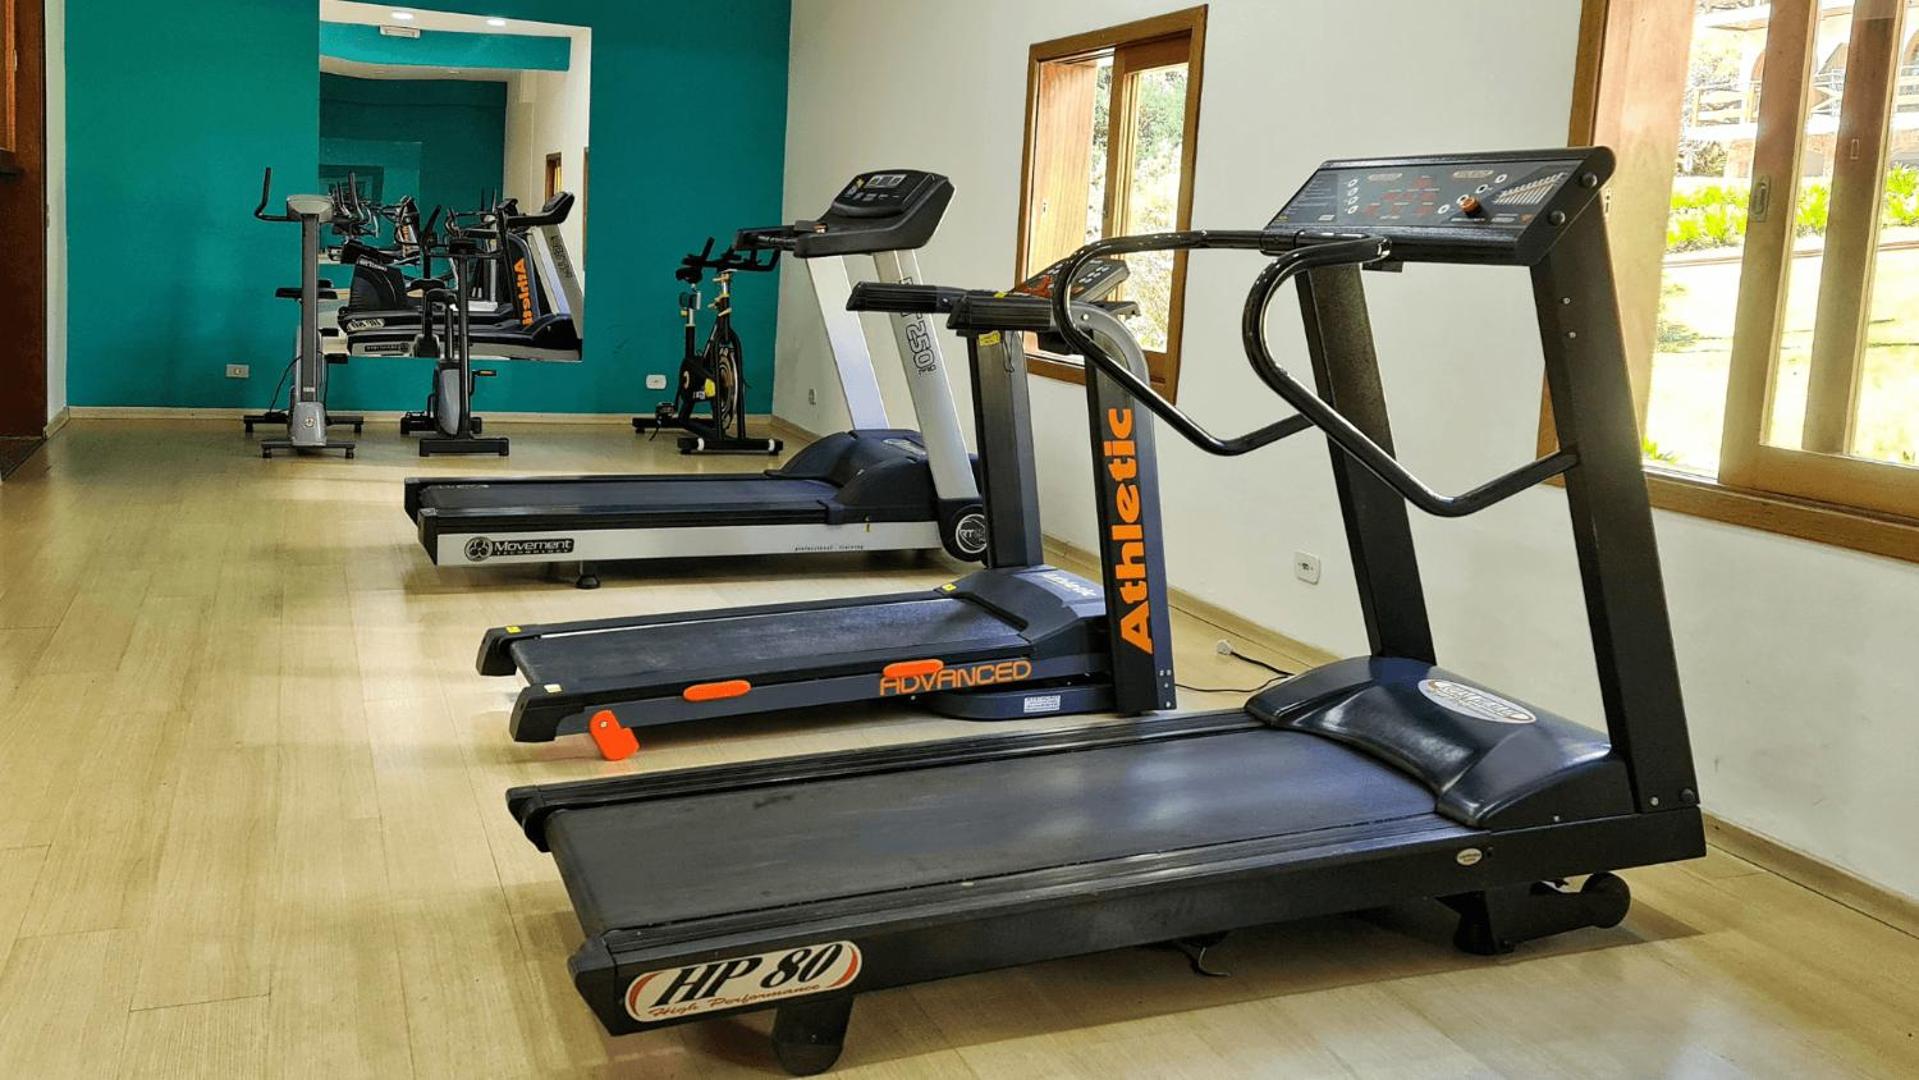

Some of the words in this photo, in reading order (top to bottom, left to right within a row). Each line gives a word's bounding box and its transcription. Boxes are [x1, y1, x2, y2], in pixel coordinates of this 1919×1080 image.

[905, 320, 936, 370] 250
[494, 540, 573, 551] Movement
[1104, 408, 1154, 655] Athletic
[880, 661, 1032, 696] ADVANCED
[649, 956, 764, 1009] HP
[760, 943, 844, 989] 80
[648, 1002, 700, 1018] High
[707, 983, 821, 1009] Performance
